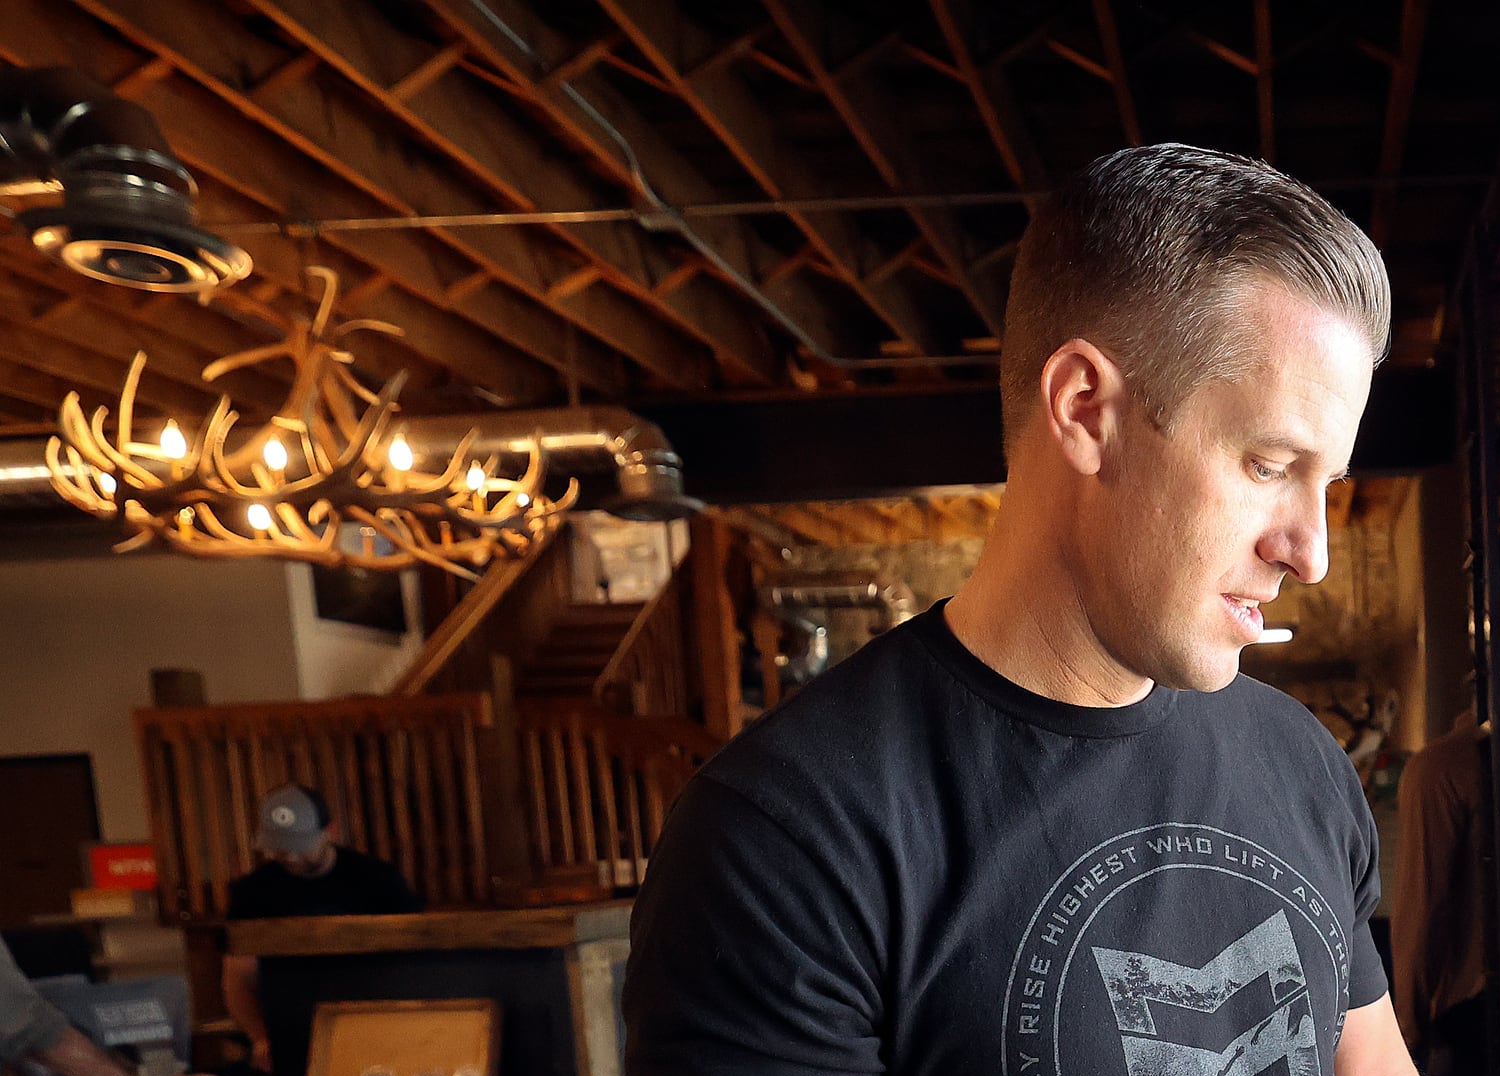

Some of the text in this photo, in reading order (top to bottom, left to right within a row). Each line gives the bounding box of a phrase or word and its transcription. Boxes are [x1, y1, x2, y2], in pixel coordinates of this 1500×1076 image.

[1019, 954, 1050, 1034] RISE
[1041, 846, 1136, 945] HIGHEST
[1147, 836, 1212, 855] WHO
[1225, 845, 1283, 880] LIFT
[1293, 886, 1323, 917] AS
[1328, 923, 1350, 997] THEY
